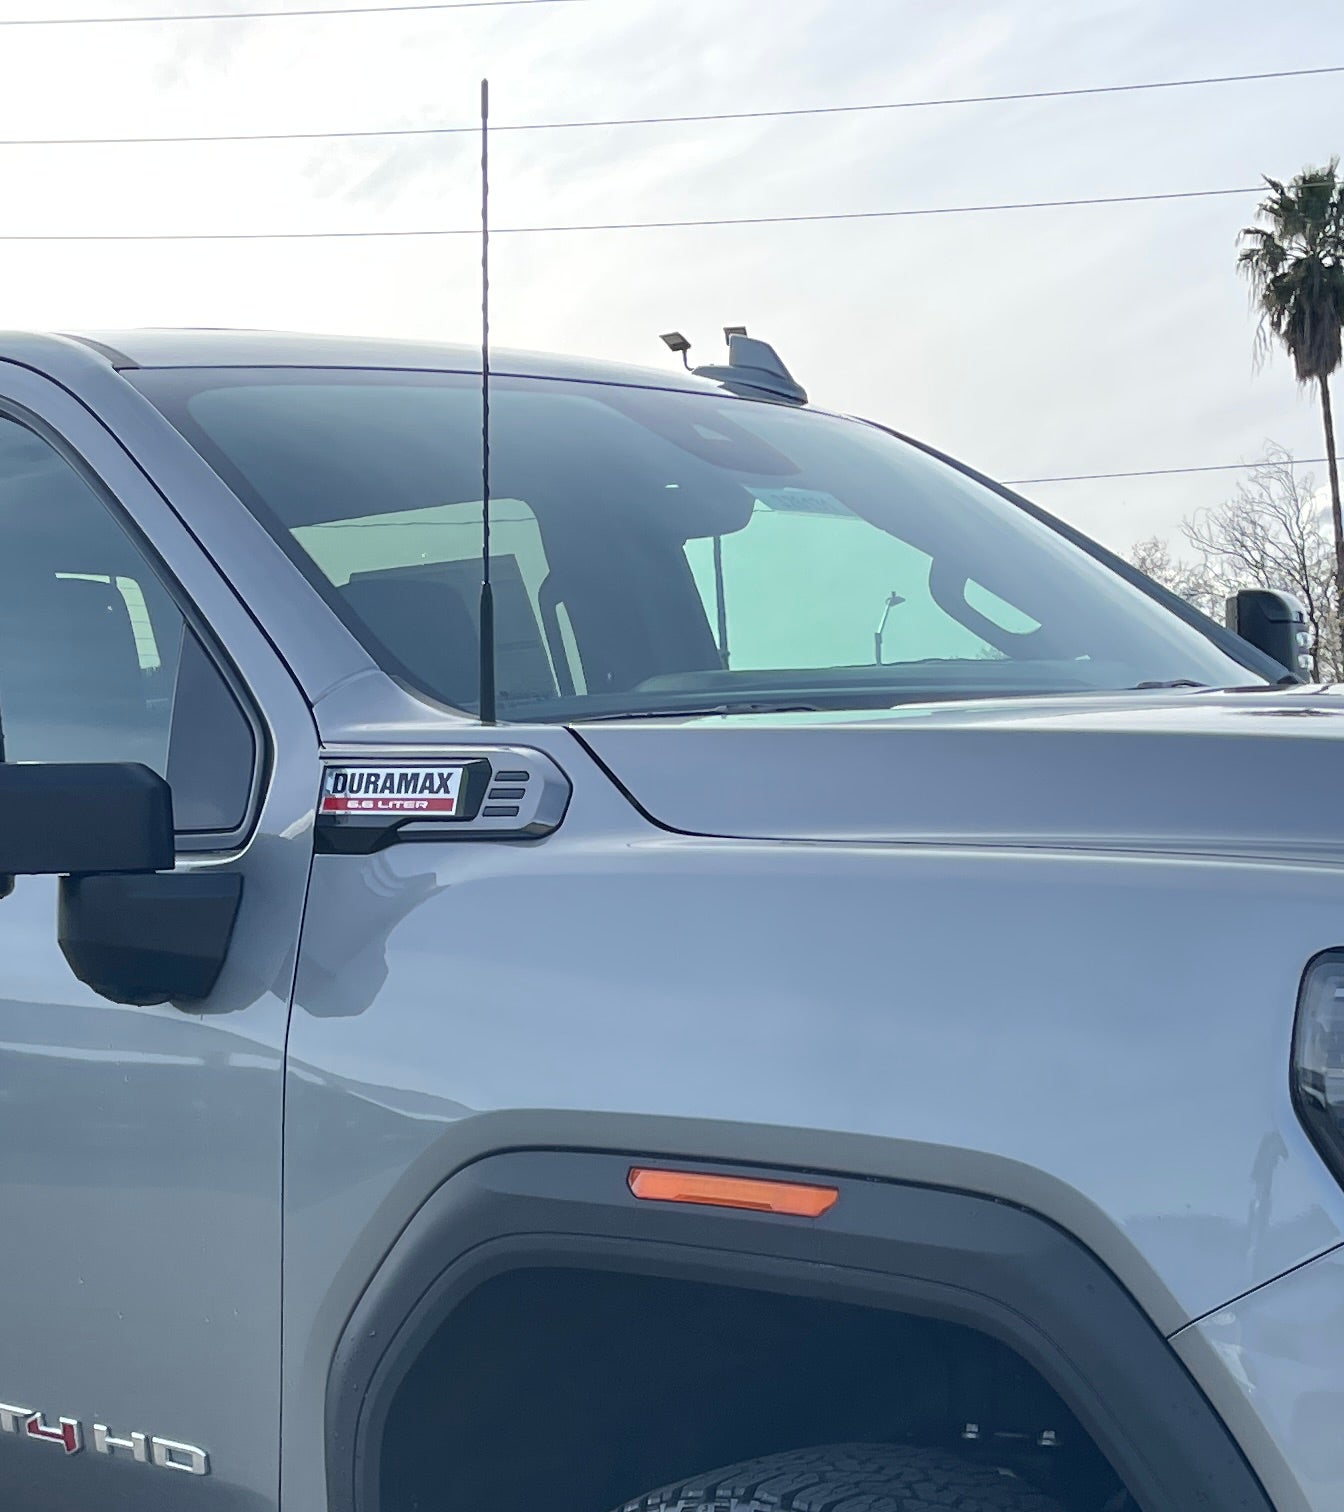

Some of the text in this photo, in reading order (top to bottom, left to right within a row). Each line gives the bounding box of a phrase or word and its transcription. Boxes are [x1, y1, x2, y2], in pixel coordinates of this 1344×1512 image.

[331, 771, 454, 795] DURAMAX
[346, 800, 429, 809] 6.6 LITER
